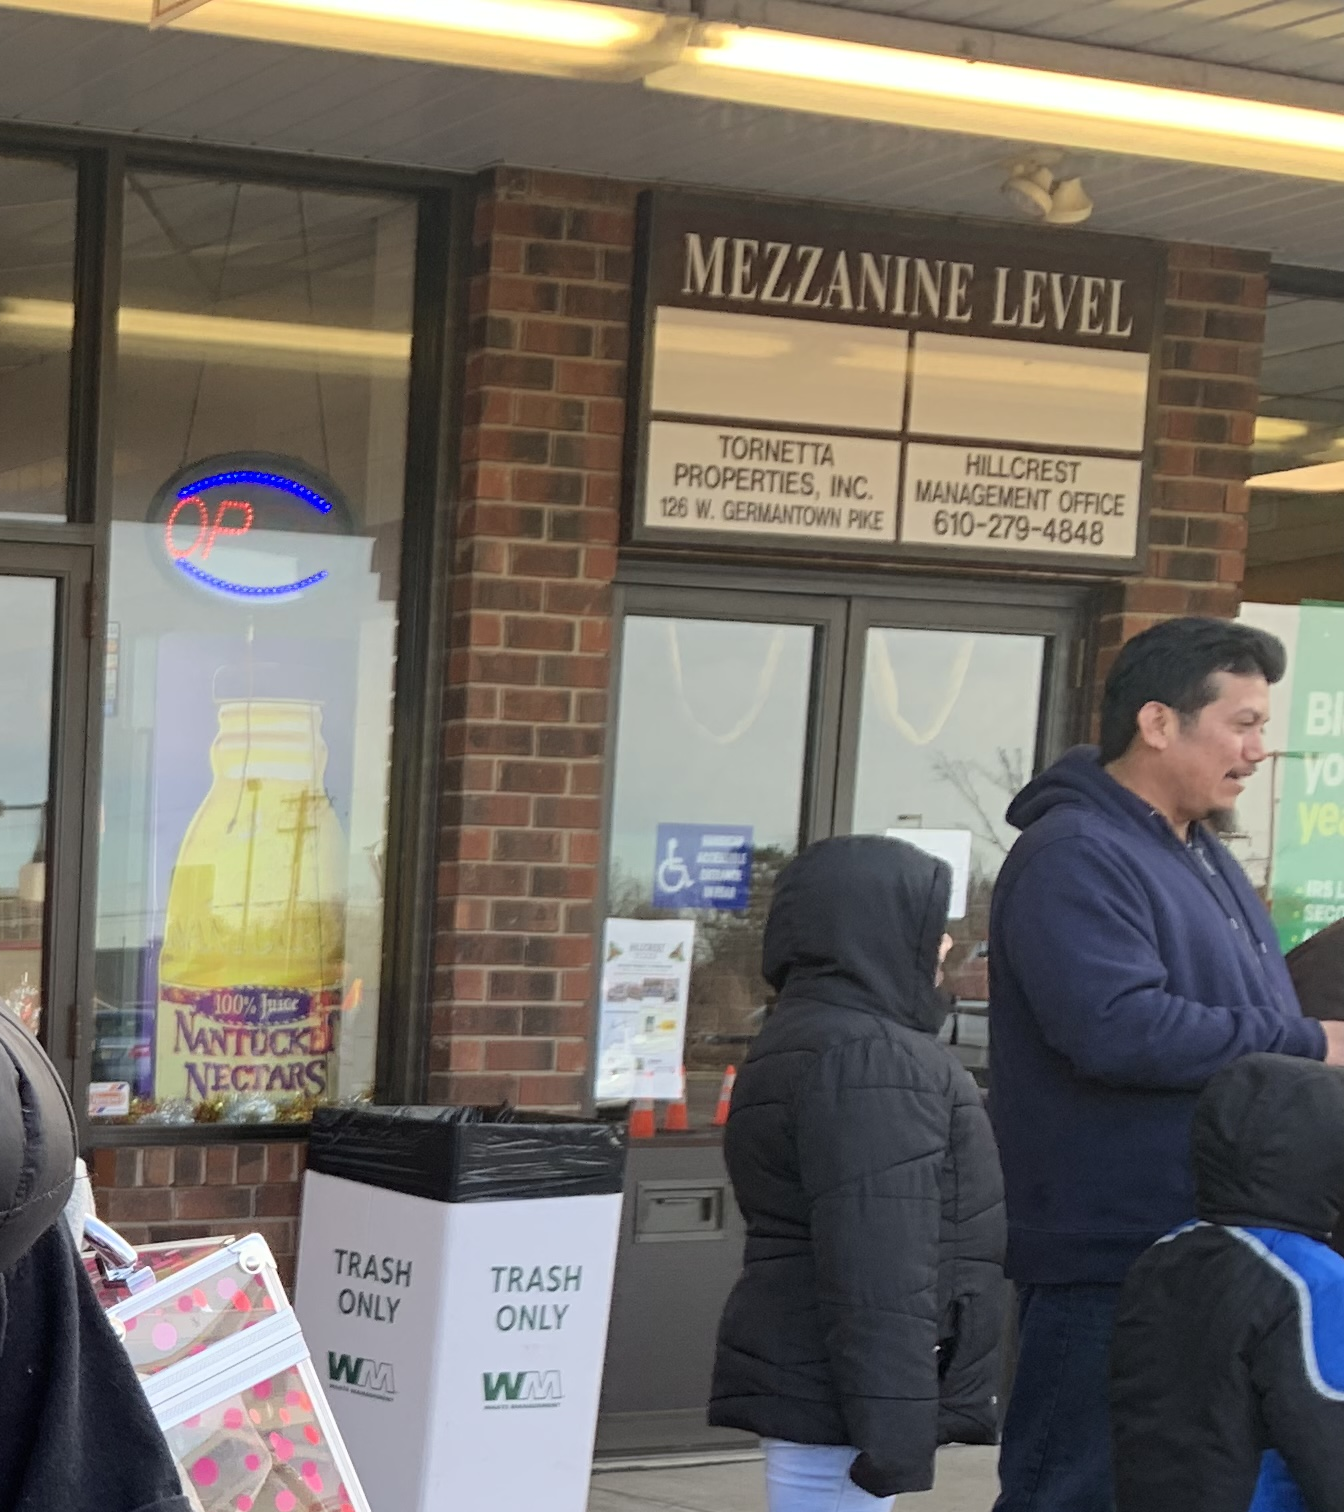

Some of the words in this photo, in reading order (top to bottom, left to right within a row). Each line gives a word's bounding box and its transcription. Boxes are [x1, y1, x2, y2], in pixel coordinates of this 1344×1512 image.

[681, 232, 976, 323] MEZZANINE
[992, 266, 1134, 338] LEVEL
[719, 434, 835, 467] TORNETTA
[965, 453, 1082, 484] HILLCREST
[673, 462, 820, 500] PROPERTIES,
[830, 474, 873, 501] INC.
[914, 478, 1053, 512] MANAGEMENT
[1059, 490, 1126, 517] OFFICE
[660, 496, 688, 519] 126
[695, 498, 715, 520] W.
[722, 499, 842, 529] GERMANTOWN
[848, 508, 885, 531] PIKE
[934, 509, 1105, 546] 610-279-4848
[214, 993, 258, 1016] 100%
[185, 1059, 327, 1101] NECTARS
[334, 1248, 413, 1287] TRASH
[490, 1265, 583, 1293] TRASH
[338, 1288, 401, 1324] ONLY
[496, 1304, 570, 1332] ONLY
[327, 1350, 397, 1395] WM
[482, 1370, 564, 1401] WM
